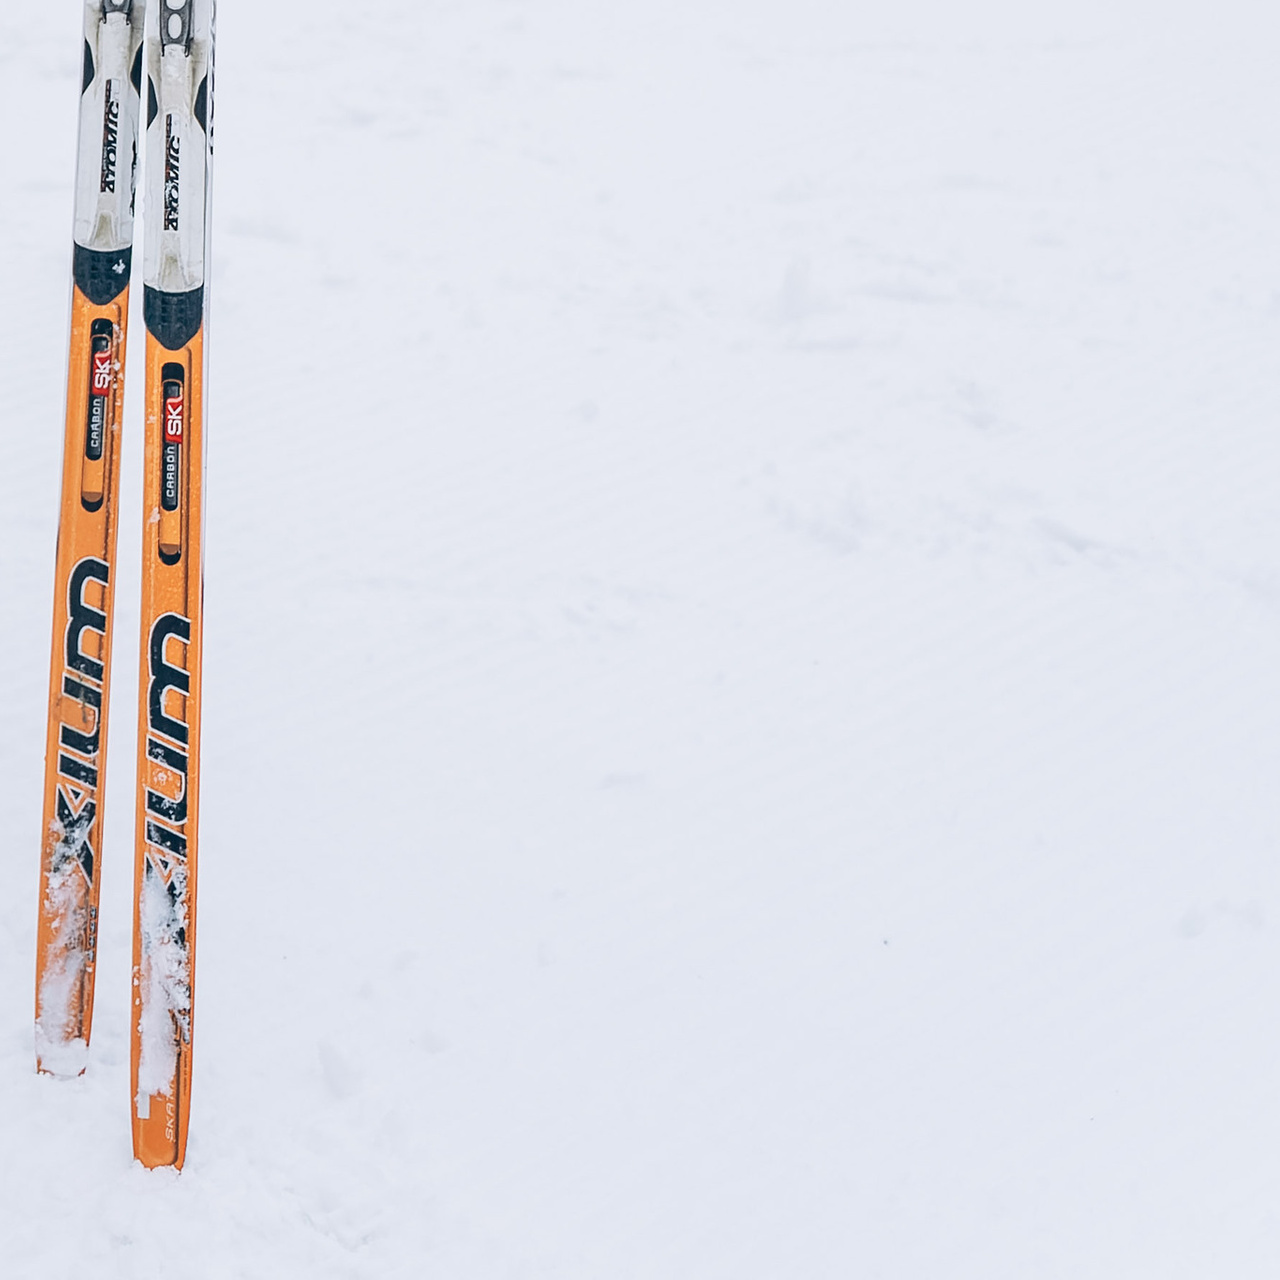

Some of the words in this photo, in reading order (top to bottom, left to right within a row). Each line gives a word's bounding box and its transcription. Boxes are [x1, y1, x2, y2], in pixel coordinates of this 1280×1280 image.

[104, 100, 120, 194] ATOMIC
[167, 136, 180, 232] ATOMIC
[90, 397, 102, 448] CARBON
[166, 446, 176, 498] CARBON
